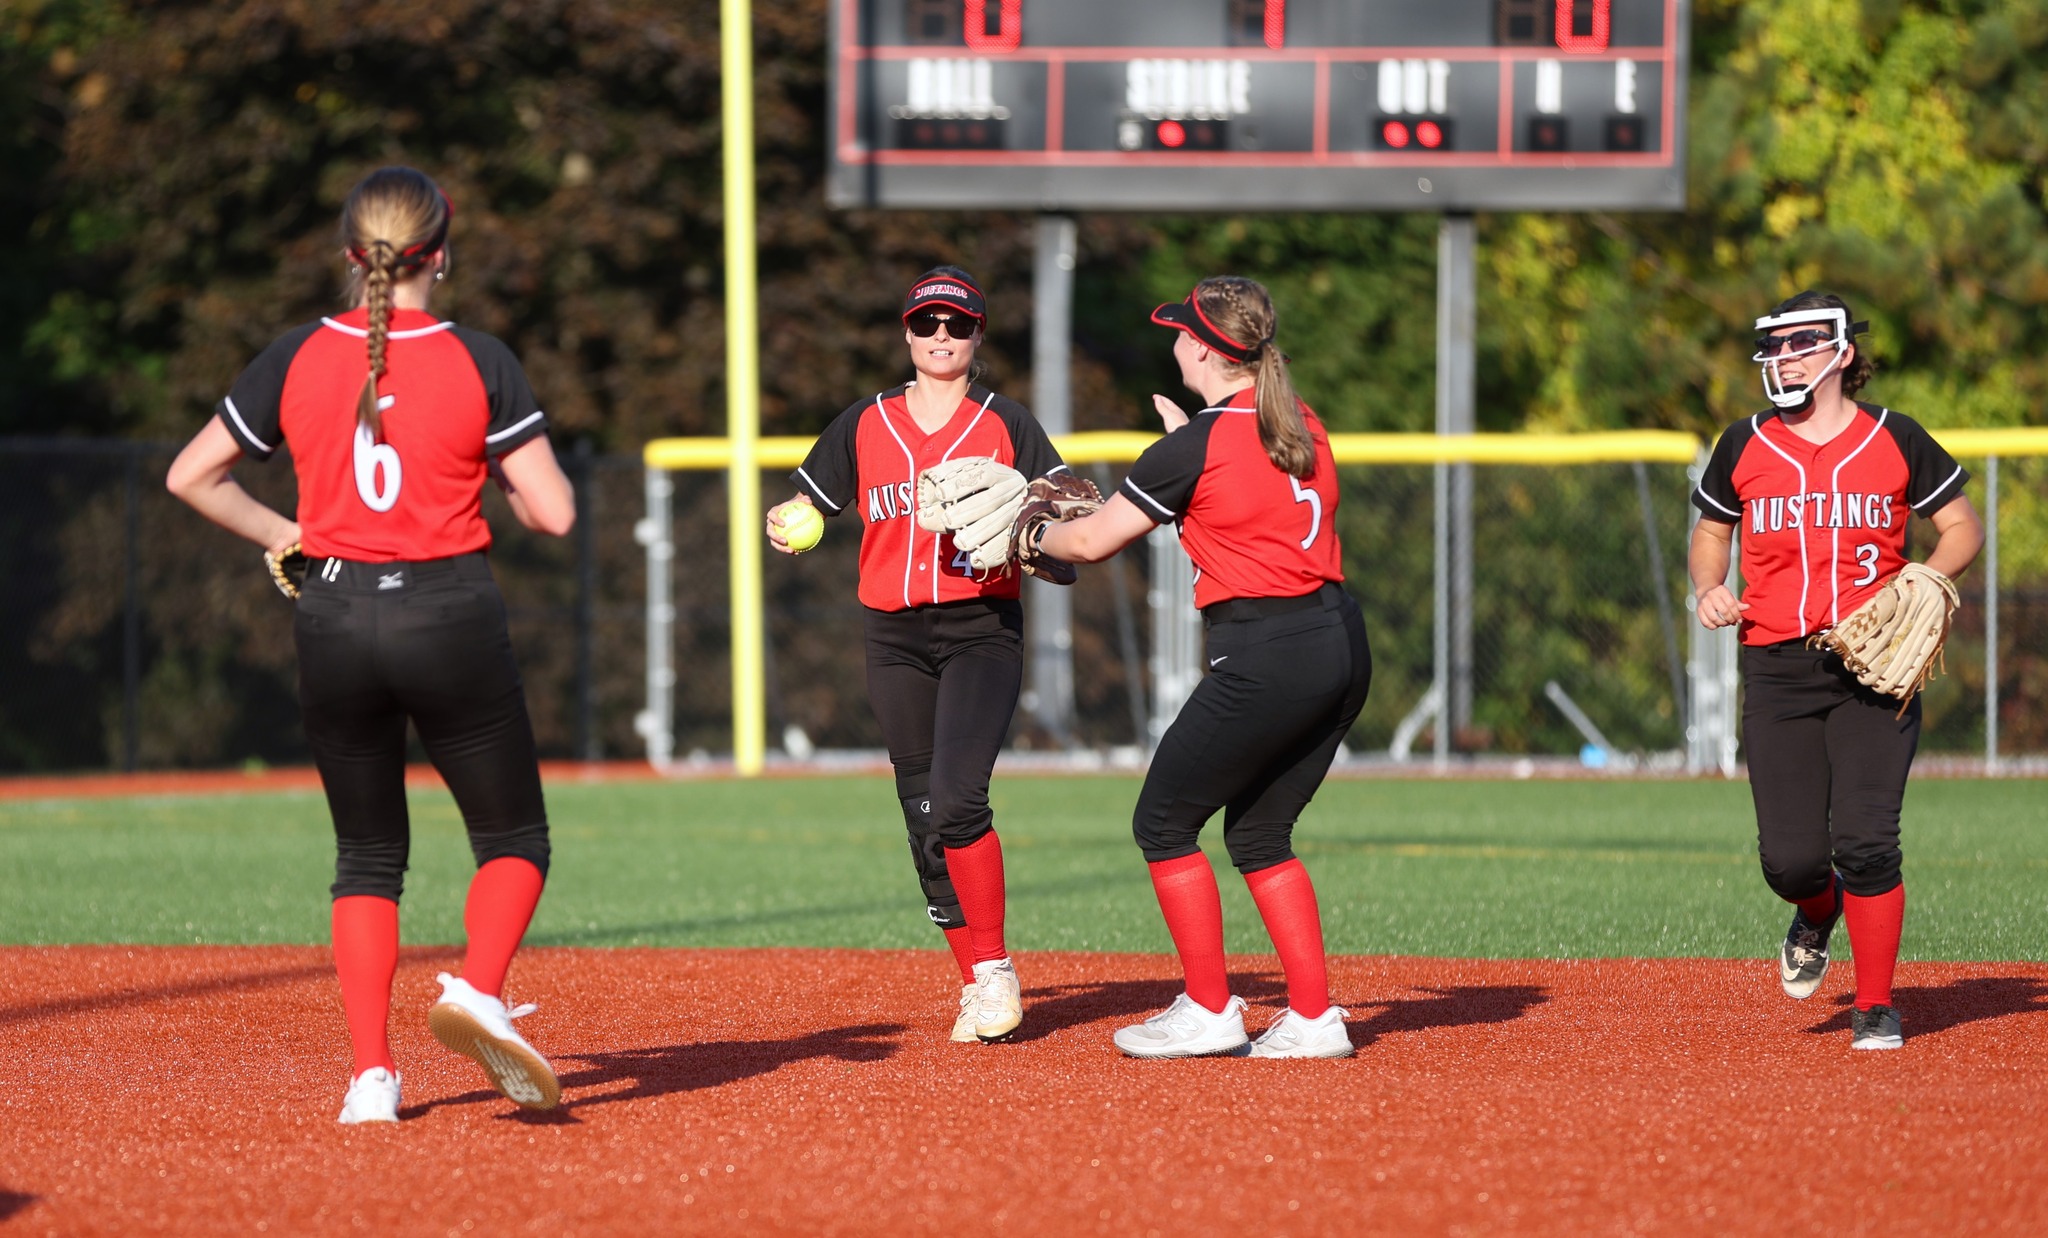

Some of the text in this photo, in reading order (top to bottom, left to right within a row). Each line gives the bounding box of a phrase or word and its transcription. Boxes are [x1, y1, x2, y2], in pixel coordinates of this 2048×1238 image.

[353, 394, 402, 513] 6
[1289, 473, 1322, 551] 5
[1750, 491, 1893, 534] MUSTANGS
[951, 549, 975, 578] 4
[1853, 542, 1881, 587] 3
